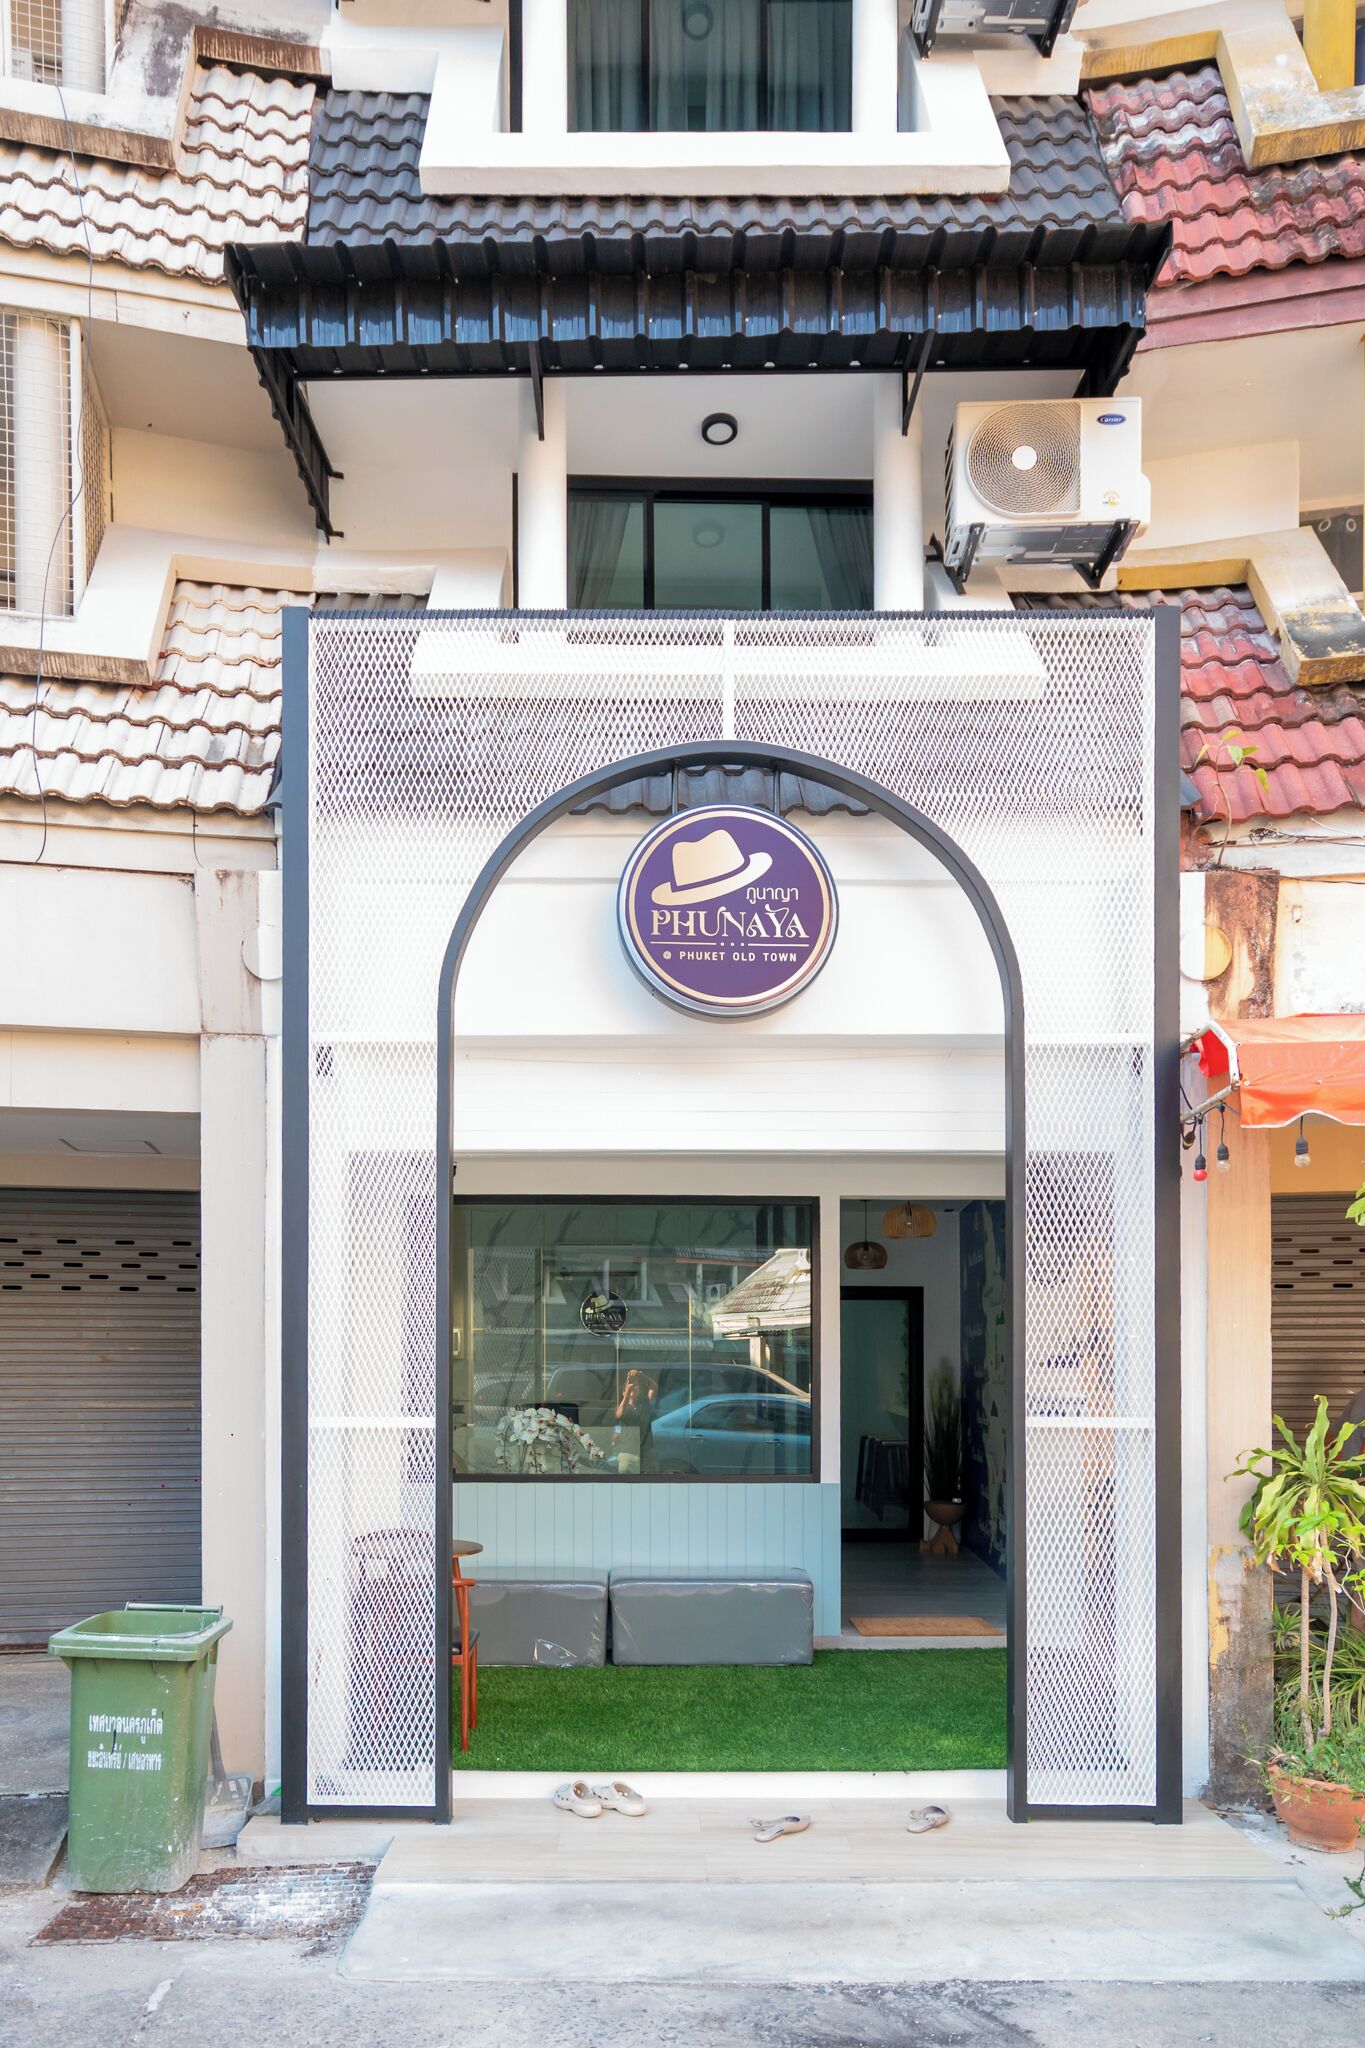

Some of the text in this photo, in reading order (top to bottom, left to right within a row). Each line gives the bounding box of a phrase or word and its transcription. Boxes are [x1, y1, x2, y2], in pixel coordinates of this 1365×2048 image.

[746, 887, 799, 904] ภูนาญา
[650, 903, 810, 938] PHUNAYA
[679, 951, 726, 962] PHUKET
[732, 952, 756, 962] OLD
[763, 953, 797, 962] TOWN
